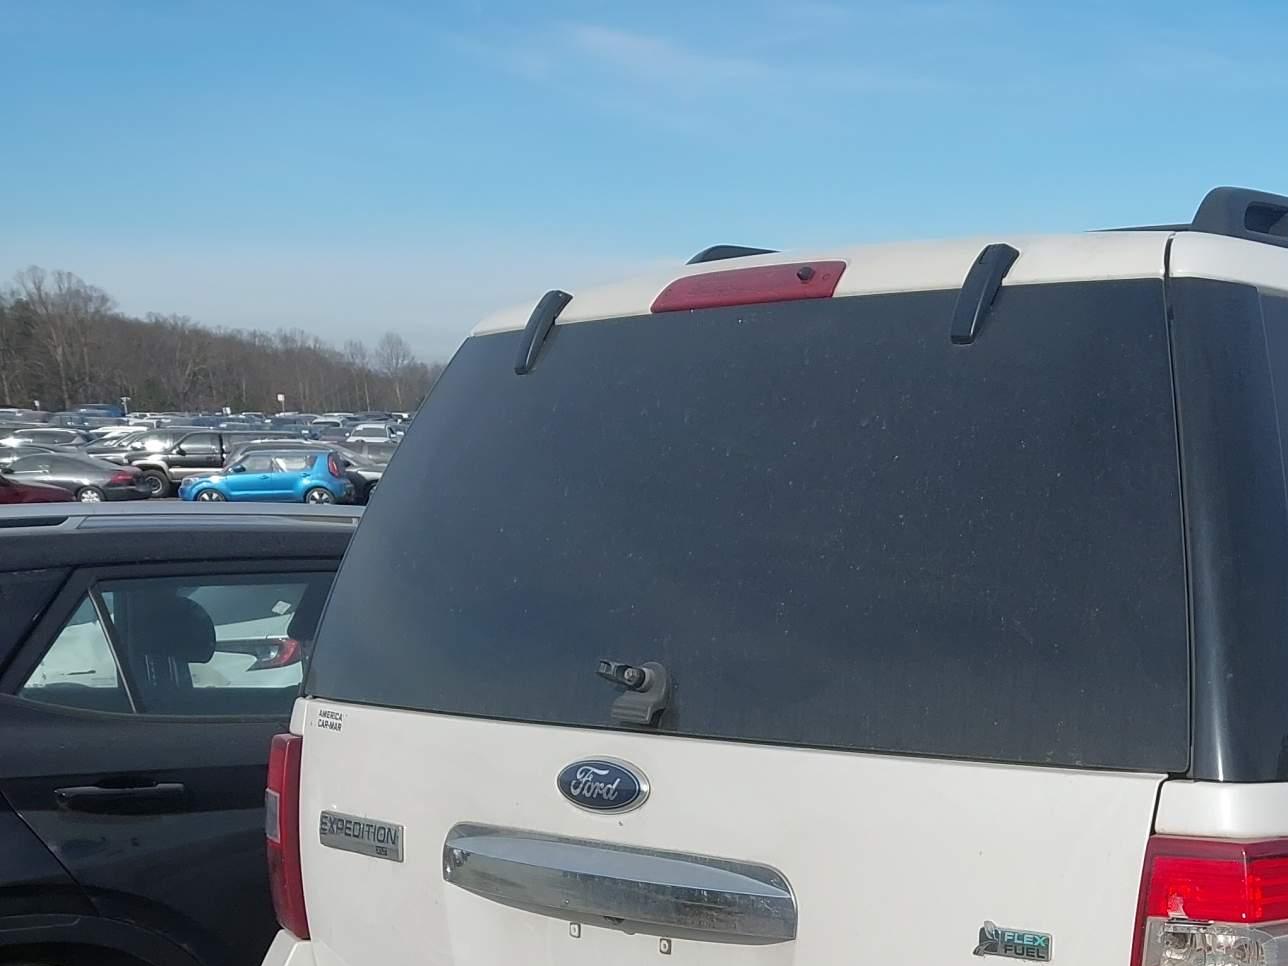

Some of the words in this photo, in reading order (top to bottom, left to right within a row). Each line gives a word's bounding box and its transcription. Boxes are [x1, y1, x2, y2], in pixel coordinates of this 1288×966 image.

[570, 766, 620, 800] Ford
[320, 815, 398, 845] EXPEDITION
[1004, 932, 1046, 947] FLEX
[1004, 944, 1046, 959] FUEL
